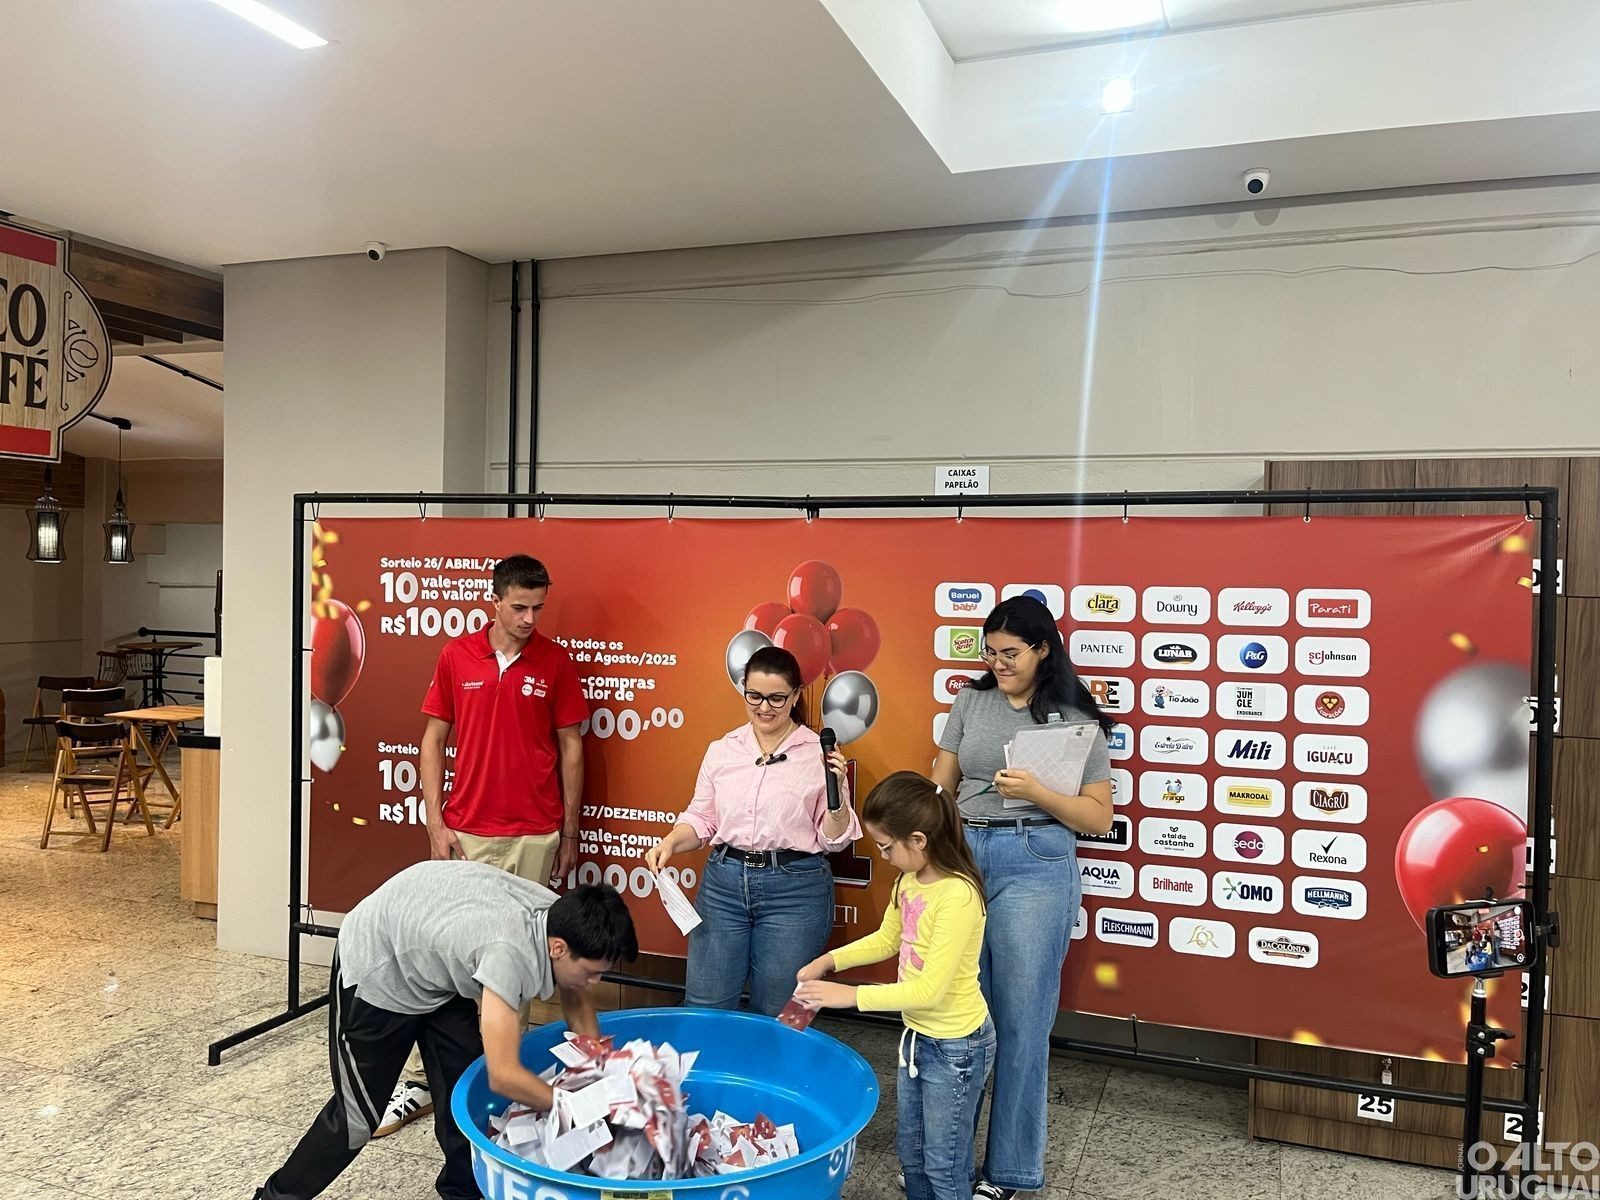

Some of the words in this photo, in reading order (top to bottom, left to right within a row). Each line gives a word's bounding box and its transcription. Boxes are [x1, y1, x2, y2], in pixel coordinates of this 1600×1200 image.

[0, 278, 47, 347] O
[948, 469, 976, 477] CAIXAS
[944, 479, 979, 489] PAPELÃO
[380, 557, 422, 569] Sorteio
[380, 572, 418, 604] 10
[421, 590, 438, 600] no
[442, 588, 480, 601] valor
[952, 603, 978, 612] baby
[1087, 594, 1118, 609] clara
[1156, 601, 1198, 616] Downy
[1233, 600, 1272, 614] Kellogg's
[1310, 603, 1351, 614] Parati
[570, 638, 606, 650] todos
[608, 641, 624, 650] os
[1080, 644, 1124, 654] PANTENE
[576, 651, 592, 662] de
[594, 652, 677, 666] Agosto/2025
[1158, 649, 1192, 658] LUNAR
[1245, 650, 1266, 660] P&G
[579, 675, 656, 690] -compras
[614, 688, 634, 702] de
[1236, 690, 1253, 699] JUN
[378, 742, 420, 755] Sorteio
[1227, 739, 1272, 760] Mili
[378, 759, 417, 792] 10
[1230, 792, 1270, 800] MAKRODAL
[1312, 790, 1347, 809] CIAGRO
[582, 805, 676, 824] 27/DEZEMBRO
[580, 842, 598, 854] no
[602, 844, 644, 858] valor
[1154, 839, 1194, 848] castanha
[1233, 840, 1264, 850] seda
[1310, 852, 1347, 865] Rexona
[1082, 866, 1121, 880] AQUA
[1153, 877, 1193, 893] Brilhante
[1240, 884, 1273, 902] OMO
[1308, 890, 1349, 902] HELLMANN'S
[1104, 921, 1153, 937] FLEISCHMANN
[1360, 1095, 1392, 1115] 25
[1506, 1116, 1541, 1138] 2
